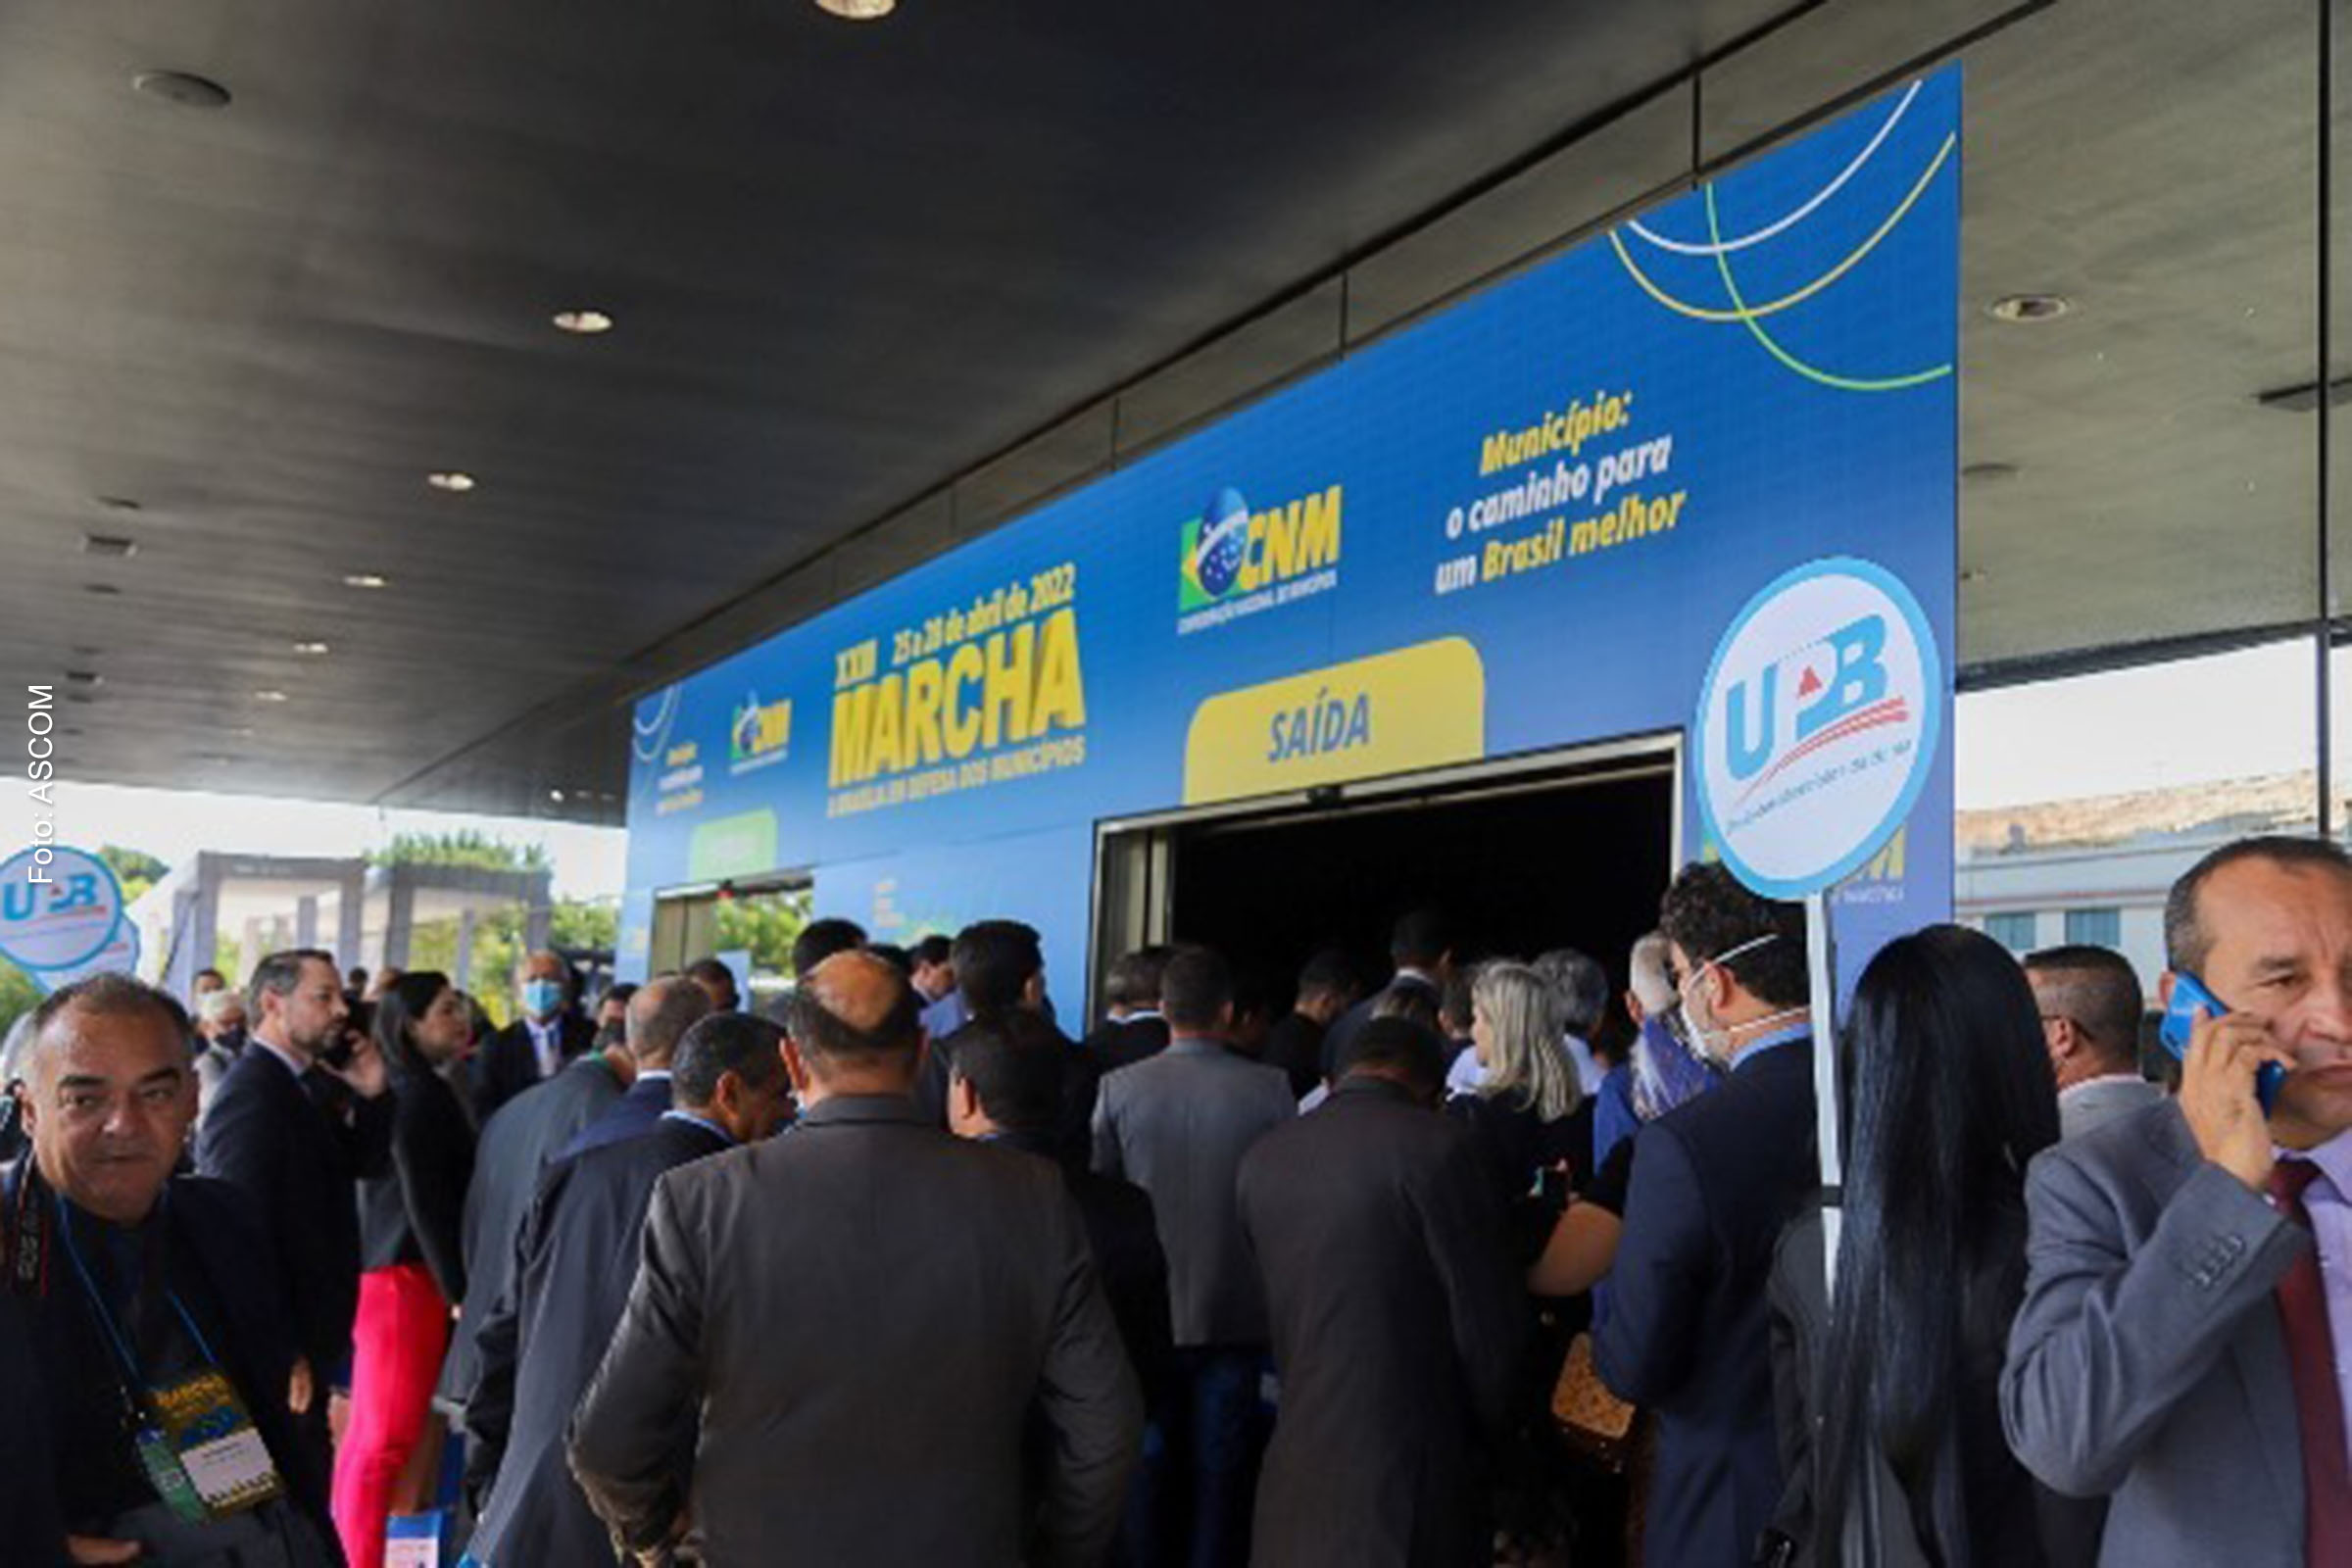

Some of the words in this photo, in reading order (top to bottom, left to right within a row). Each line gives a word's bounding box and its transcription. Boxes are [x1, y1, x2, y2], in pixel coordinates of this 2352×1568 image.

[1479, 390, 1633, 476] Município:
[1240, 484, 1342, 591] CNM
[1446, 507, 1464, 539] o
[1469, 460, 1591, 531] caminho
[1593, 434, 1673, 505] para
[1435, 555, 1477, 595] um
[1482, 515, 1565, 582] Brasil
[1567, 489, 1687, 557] melhor
[828, 607, 1086, 790] MARCHA
[1267, 686, 1370, 762] SAÍDA
